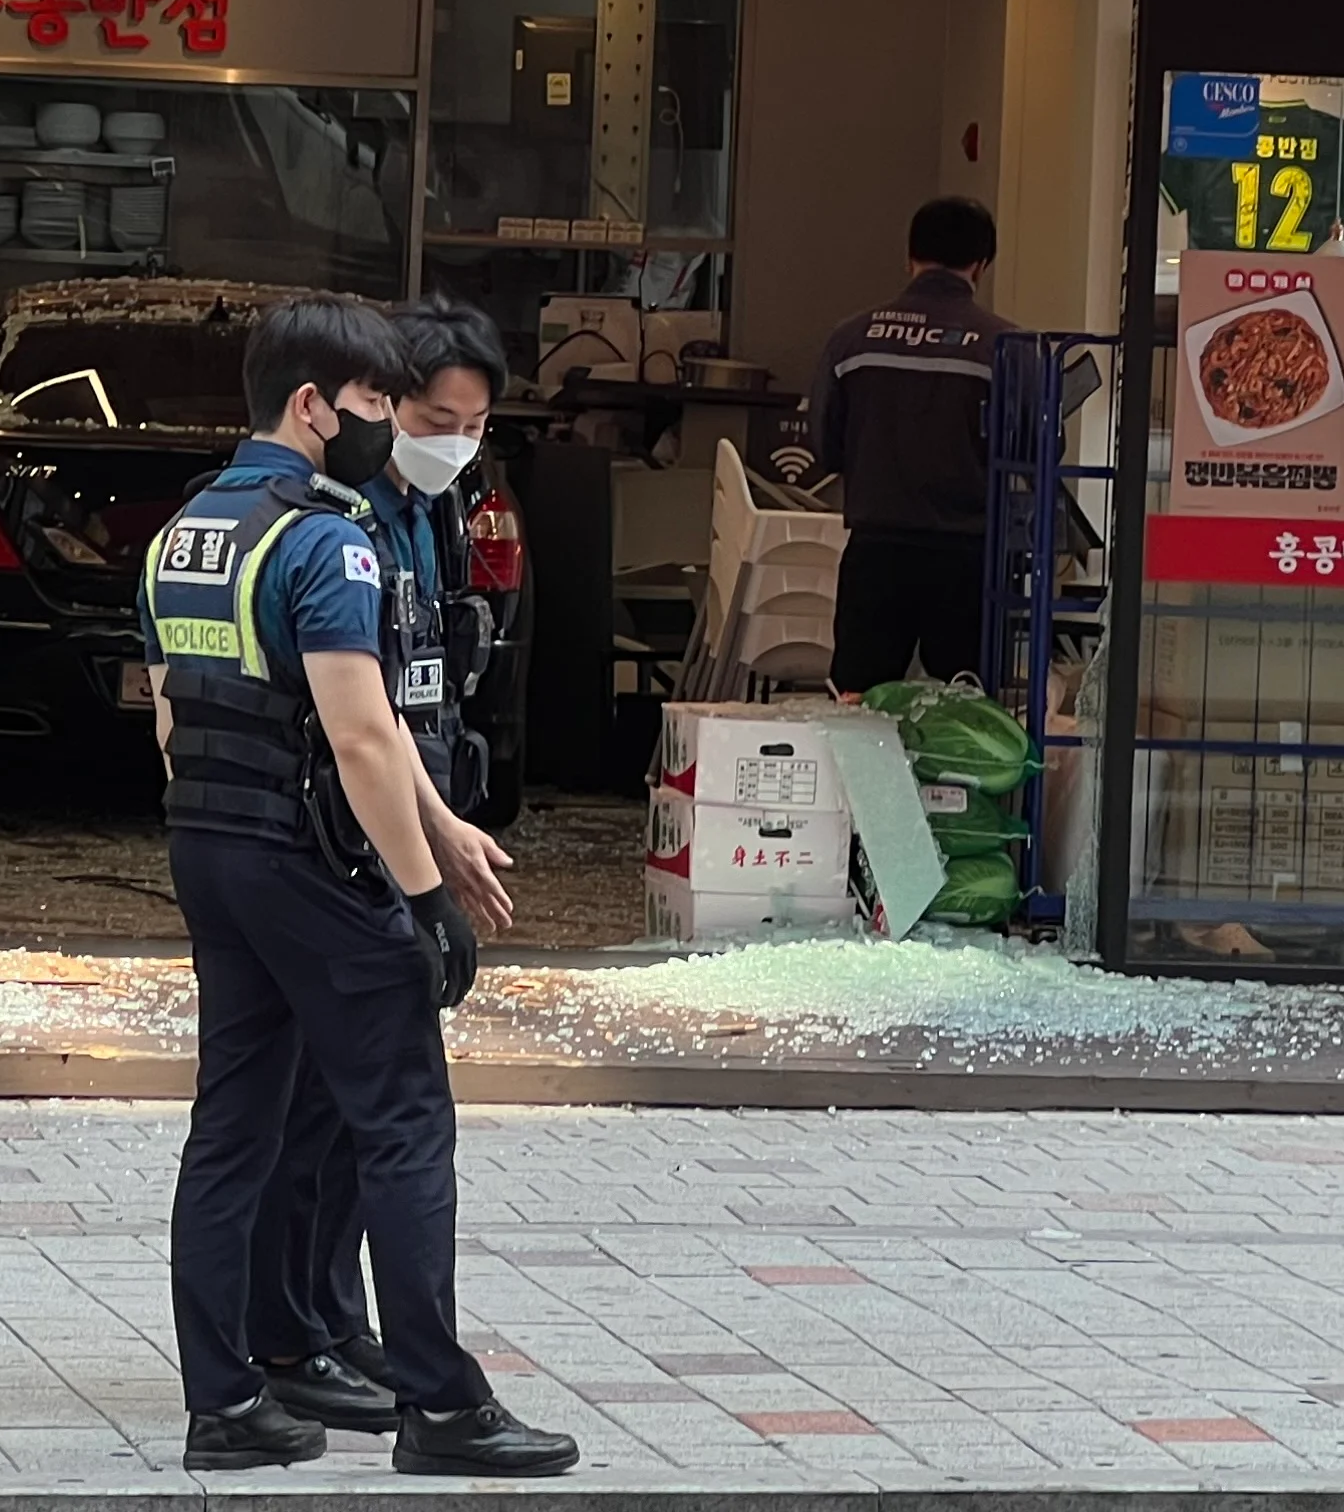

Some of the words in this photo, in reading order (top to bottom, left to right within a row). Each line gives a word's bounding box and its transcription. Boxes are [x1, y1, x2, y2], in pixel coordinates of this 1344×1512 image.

[1203, 81, 1255, 103] CESCO
[1231, 161, 1313, 252] 12
[170, 529, 225, 572] 경찰
[164, 622, 230, 653] POLICE
[408, 688, 440, 701] POLICE
